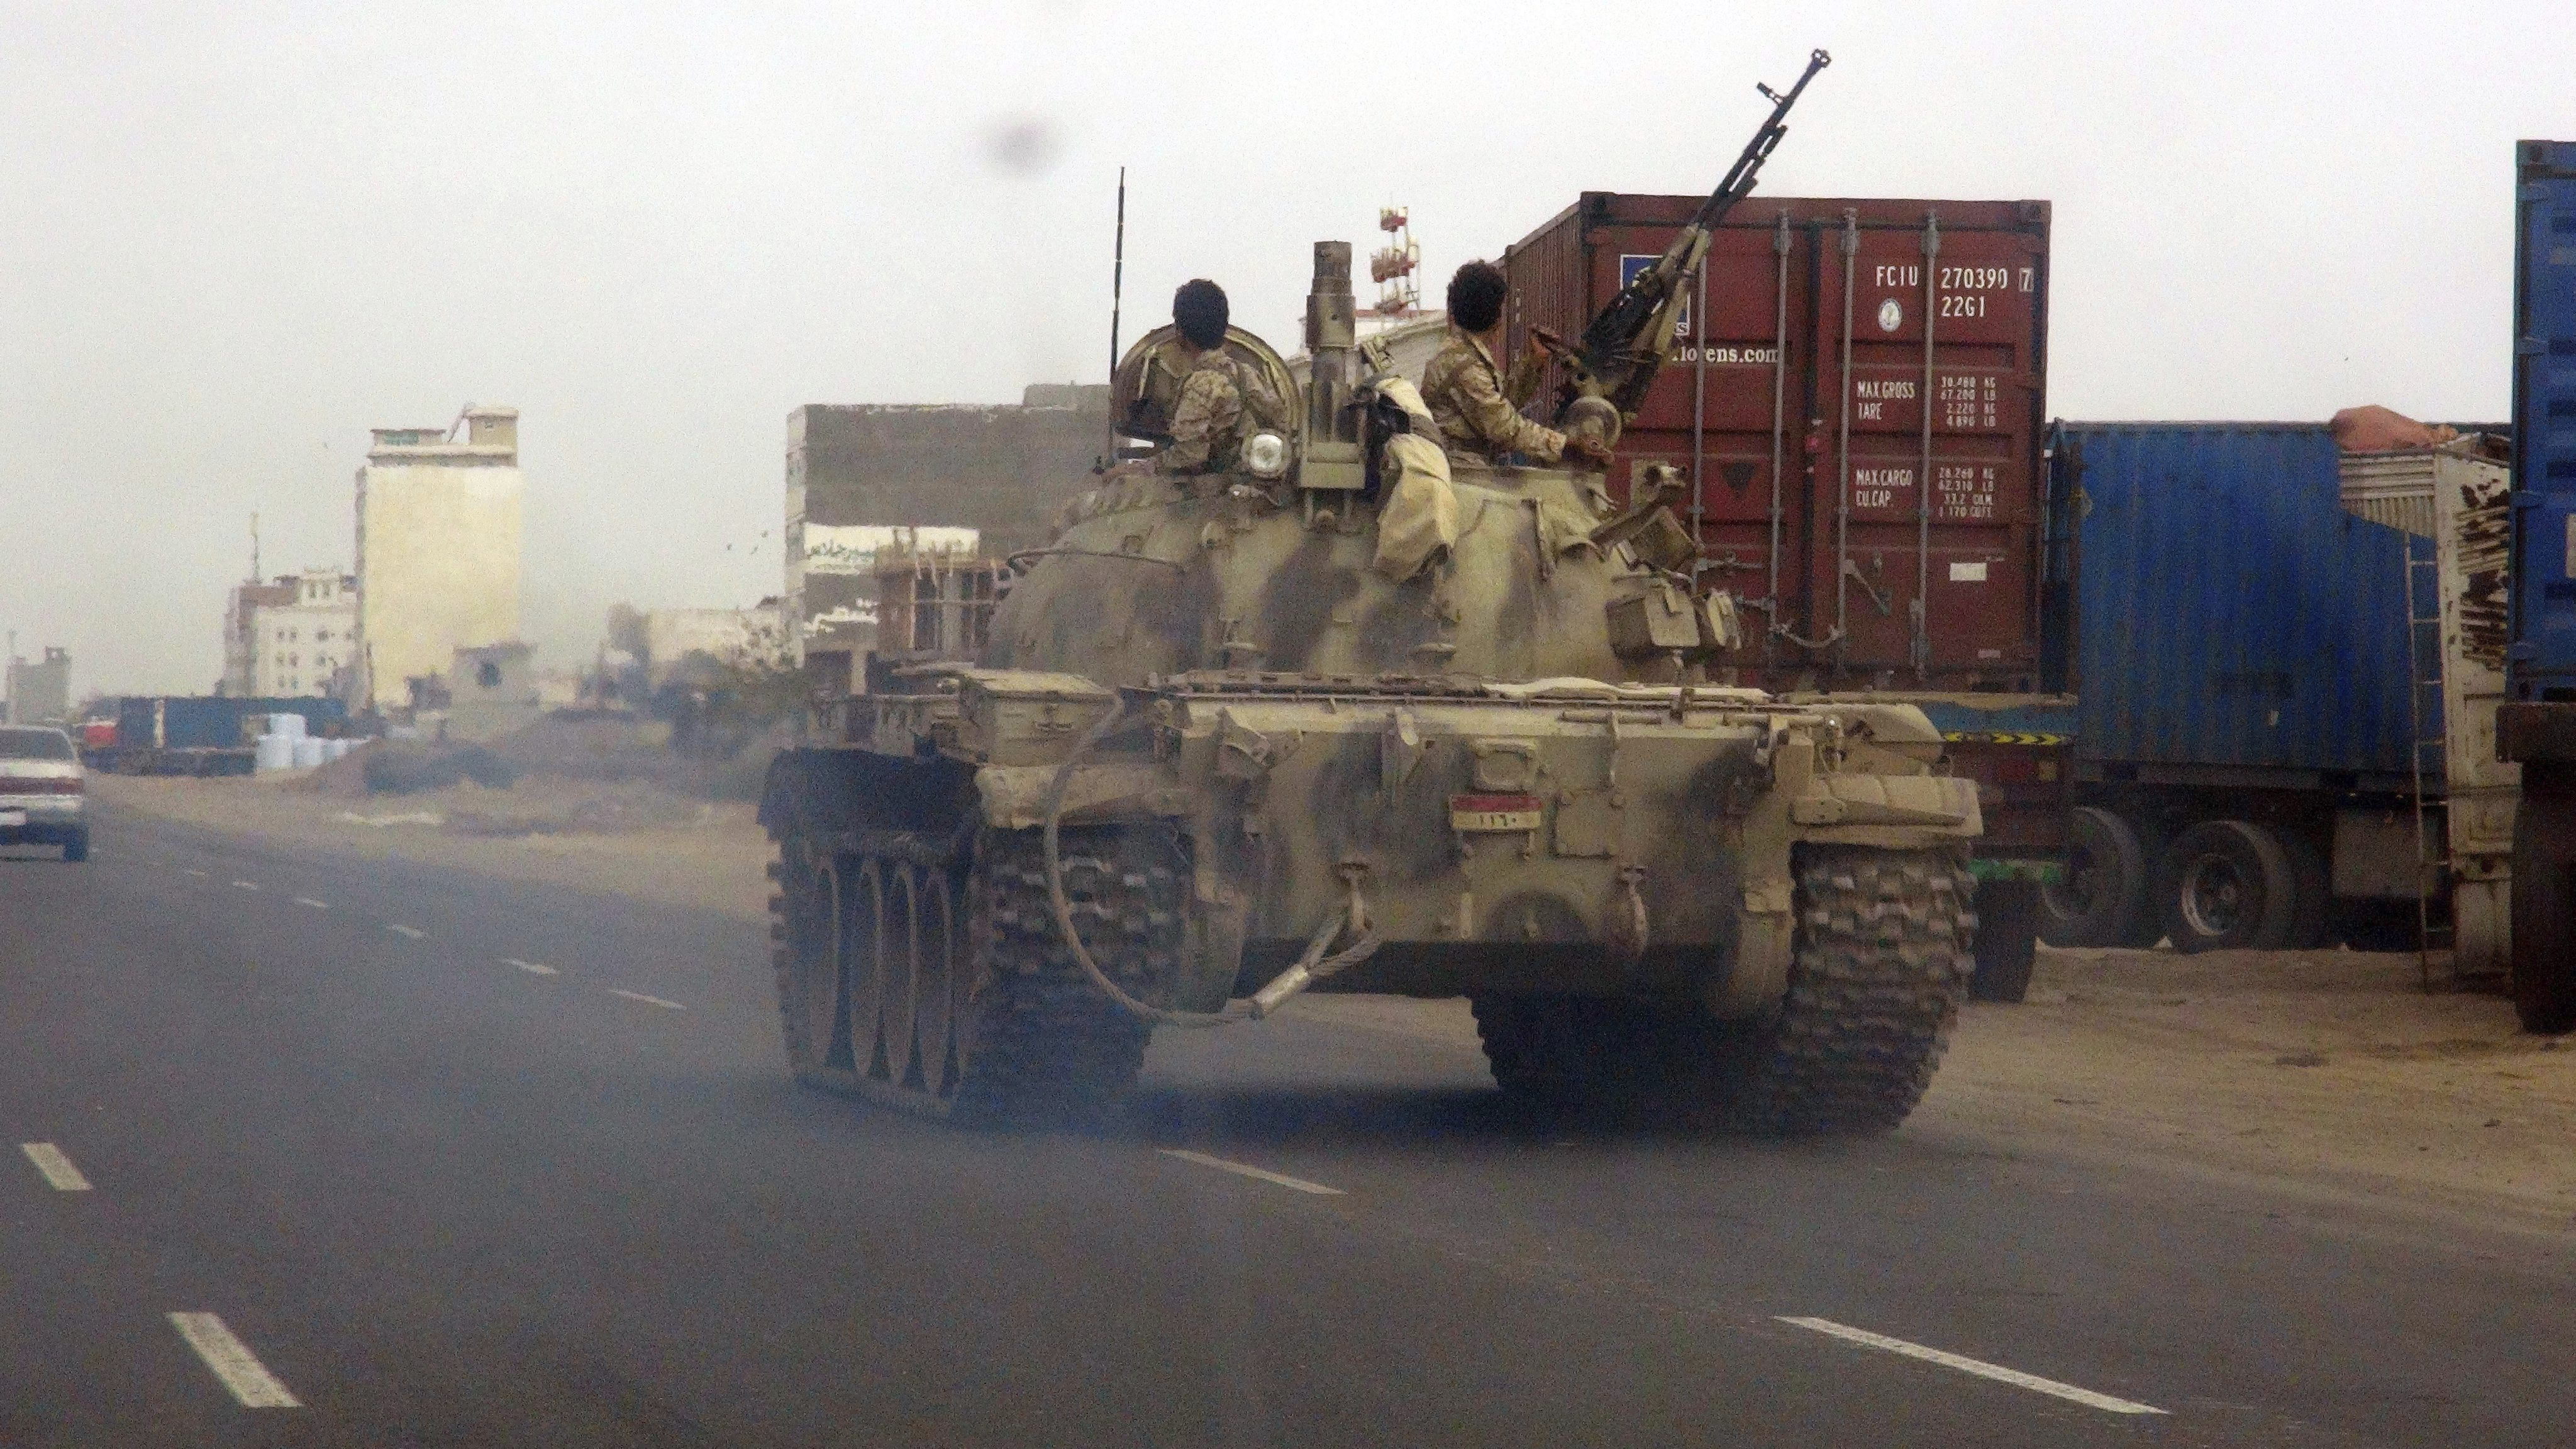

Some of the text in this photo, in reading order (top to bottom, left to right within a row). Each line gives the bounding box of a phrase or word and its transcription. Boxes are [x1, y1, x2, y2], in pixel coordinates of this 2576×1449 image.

[1875, 265, 2033, 291] FCIU 270390 7
[1941, 296, 1985, 318] 22G1
[1858, 402, 1882, 420] TARE
